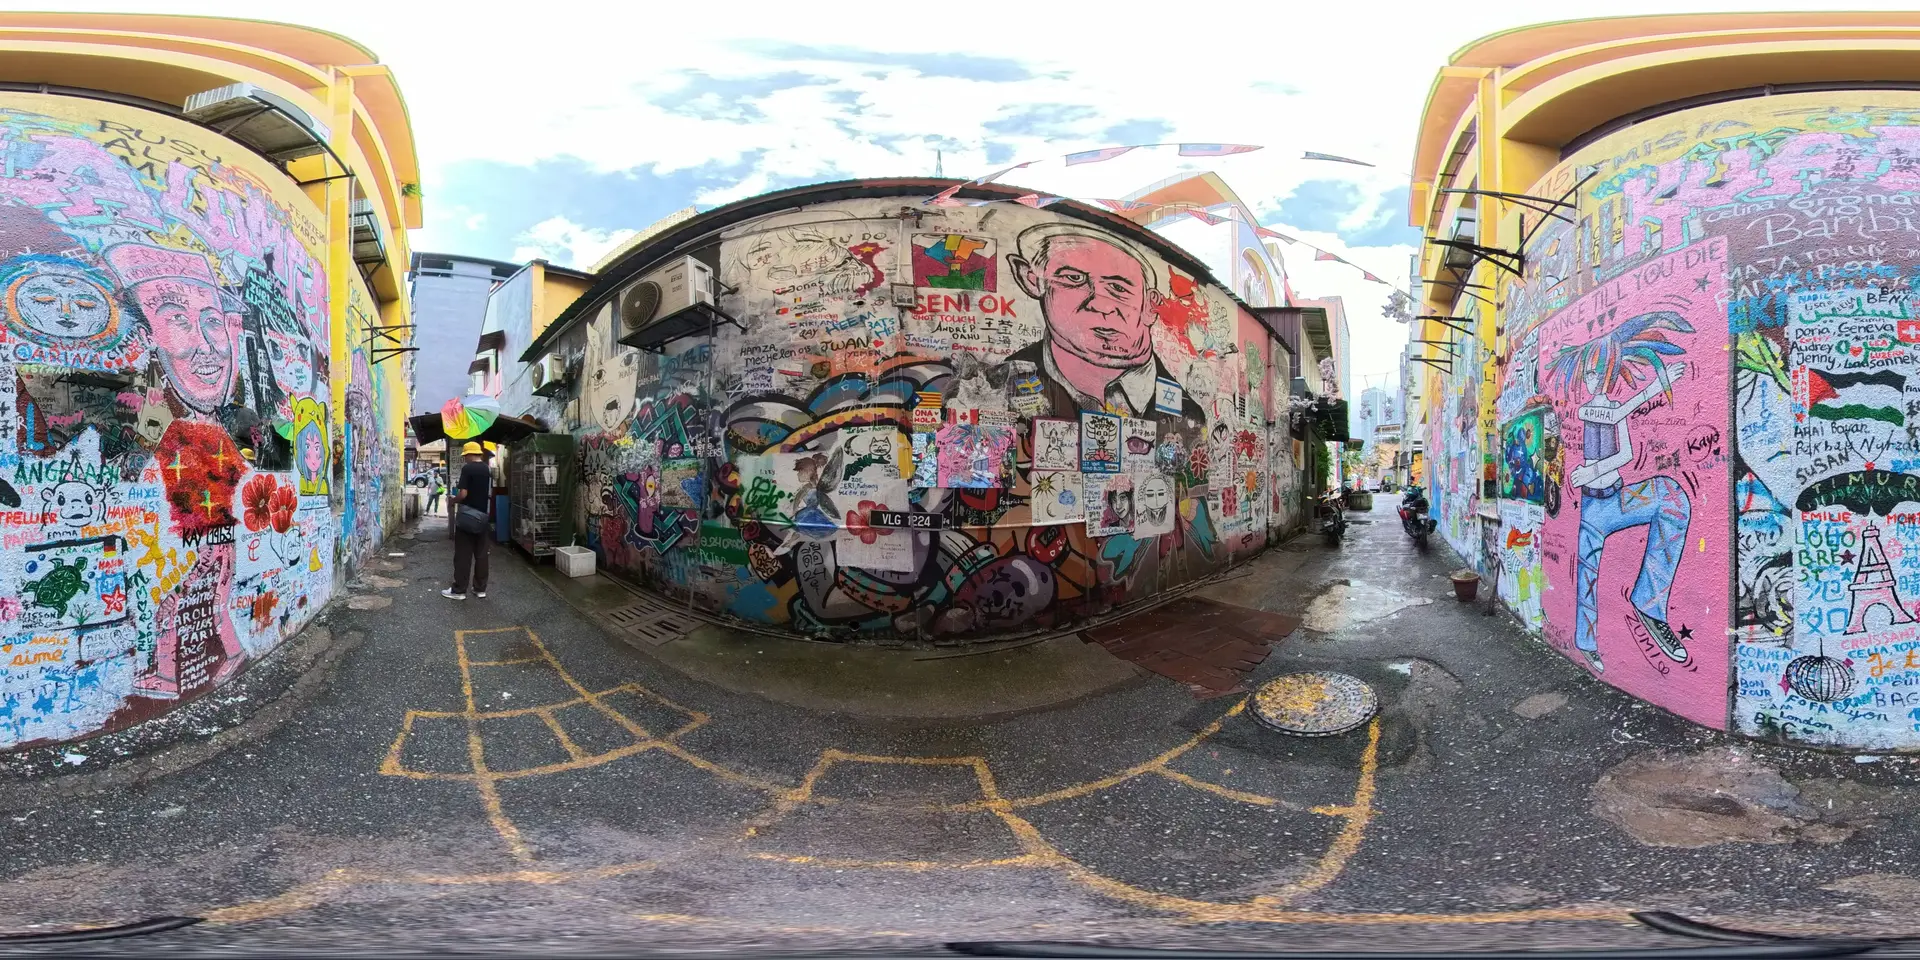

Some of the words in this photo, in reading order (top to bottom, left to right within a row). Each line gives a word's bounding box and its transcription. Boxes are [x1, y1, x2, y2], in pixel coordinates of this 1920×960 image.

[790, 281, 825, 292] Jonas
[1541, 305, 1585, 348] DANCE
[1591, 280, 1629, 314] TILL
[1632, 257, 1676, 291] YOU
[1684, 240, 1722, 270] DIE
[908, 293, 971, 315] SENI
[978, 294, 1017, 318] OK
[1838, 321, 1895, 335] Geneva
[741, 344, 777, 356] HAMZA
[1789, 340, 1835, 357] Audrey
[914, 409, 933, 417] ONA
[882, 513, 902, 526] VLG
[908, 515, 931, 528] 1224
[1801, 511, 1853, 524] EMILIE
[1739, 687, 1772, 698] JOUR
[1780, 711, 1833, 731] London
